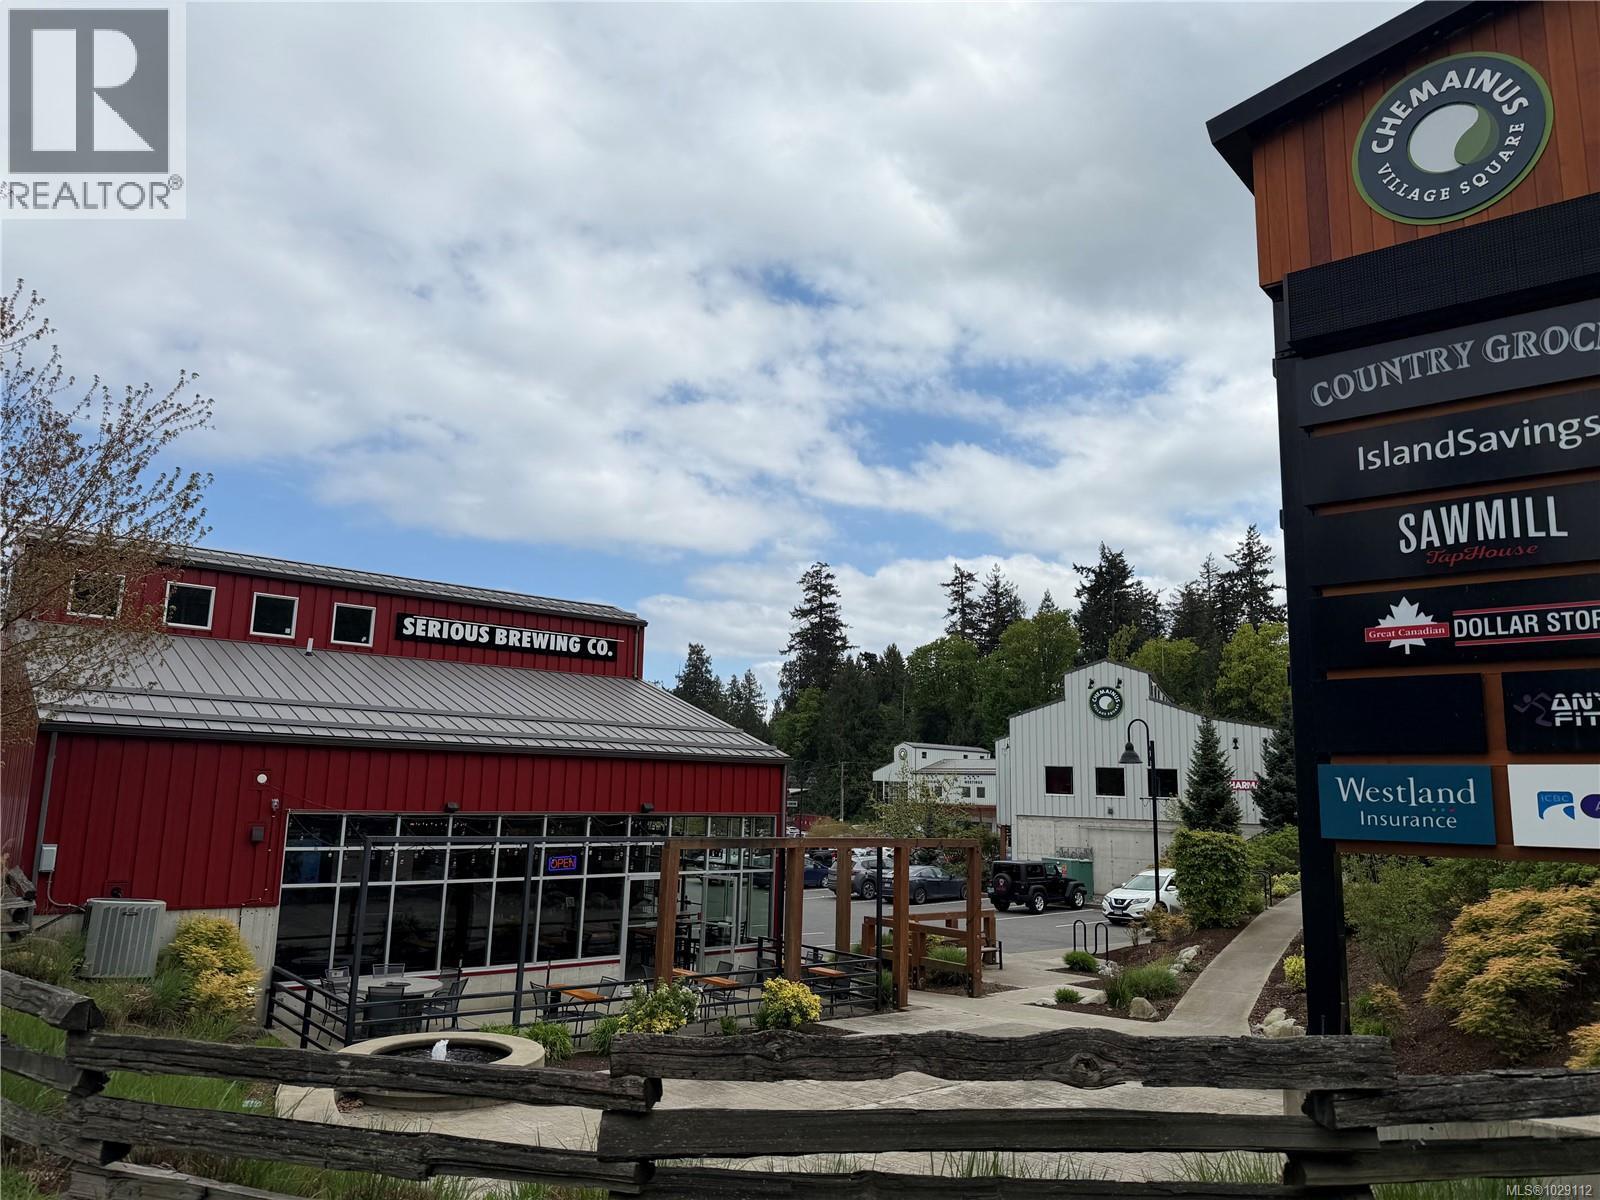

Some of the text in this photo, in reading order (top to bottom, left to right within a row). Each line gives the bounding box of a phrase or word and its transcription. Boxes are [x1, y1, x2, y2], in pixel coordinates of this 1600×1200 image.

[1371, 68, 1529, 154] CHEMAINUS
[1377, 121, 1525, 202] VILLAGE SQUARE
[1310, 321, 1600, 407] COUNTRY GROC
[1358, 414, 1600, 471] IslandSavings
[1398, 495, 1569, 554] SAWMILL
[402, 617, 613, 657] SERIOUS BREWING CO.
[1368, 629, 1396, 639] Great
[1398, 626, 1446, 637] Canadian
[1453, 613, 1540, 638] DOLLAR
[1335, 776, 1477, 807] Westland
[1360, 810, 1458, 829] Insurance
[550, 857, 576, 869] OPEN
